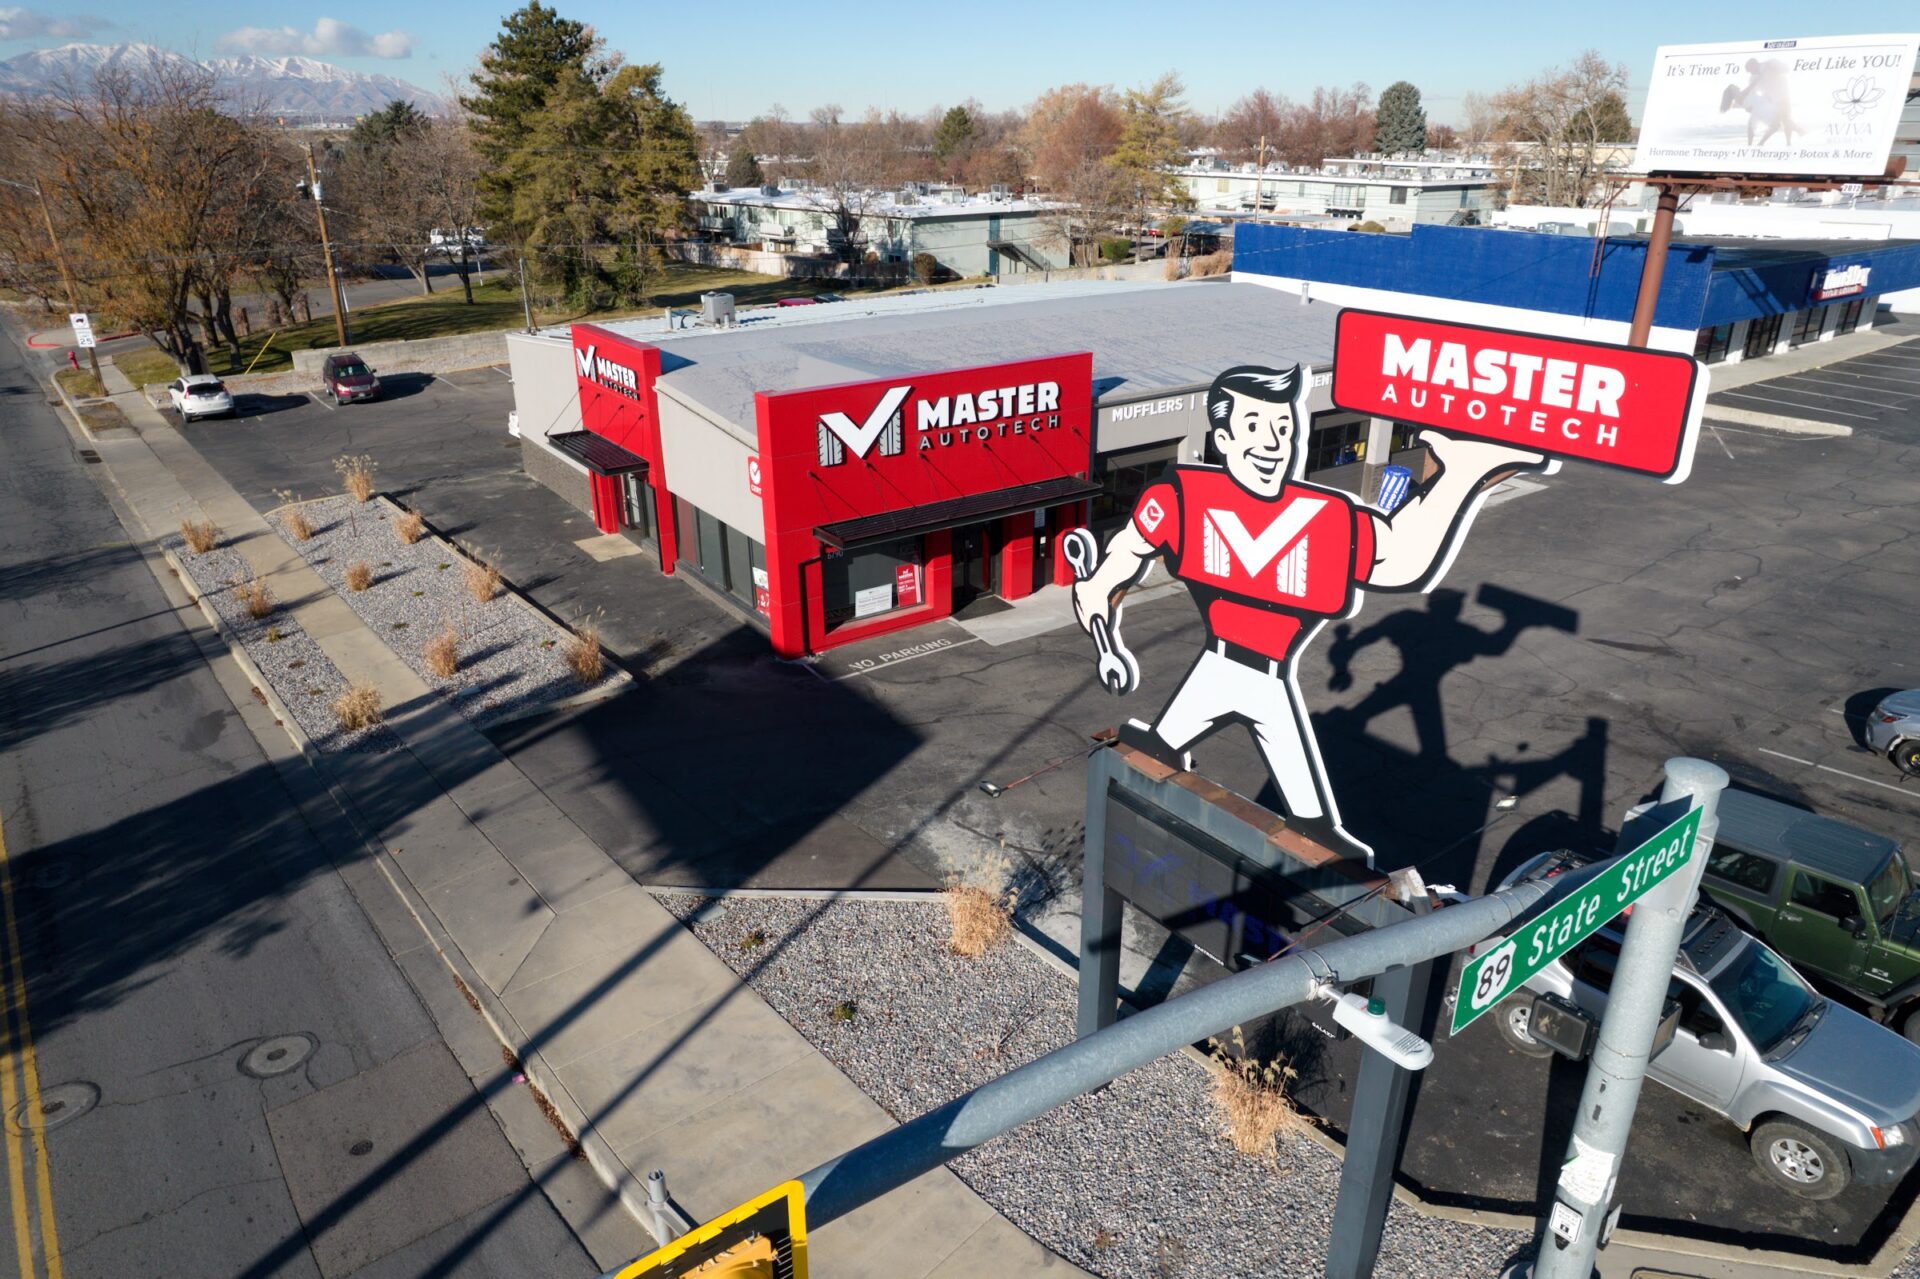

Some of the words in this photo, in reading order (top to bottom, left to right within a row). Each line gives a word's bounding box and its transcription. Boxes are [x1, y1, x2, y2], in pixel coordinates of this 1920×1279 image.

[1667, 64, 1685, 77] It's
[1689, 64, 1721, 76] Time
[1725, 63, 1740, 75] To
[1793, 57, 1822, 71] Feel
[1825, 56, 1857, 70] Like
[1862, 54, 1902, 68] YOU!
[1649, 147, 1690, 157] Hormone
[1692, 148, 1730, 159] Therapy
[1737, 149, 1749, 158] IV
[1751, 149, 1791, 160] Therapy
[1799, 149, 1830, 159] Botox
[1832, 150, 1840, 159] &
[1843, 149, 1873, 159] More
[596, 356, 637, 390] MASTER
[1381, 333, 1626, 418] MASTER
[917, 381, 1060, 431] MASTER
[1112, 398, 1183, 422] MUFFLERS
[1381, 383, 1618, 447] AUTOTECH
[919, 415, 1059, 450] AUTOTECH
[848, 659, 875, 670] NO
[878, 639, 952, 662] PARKING
[1477, 954, 1511, 1000] 89
[1528, 894, 1601, 967] State
[1617, 823, 1692, 902] Street
